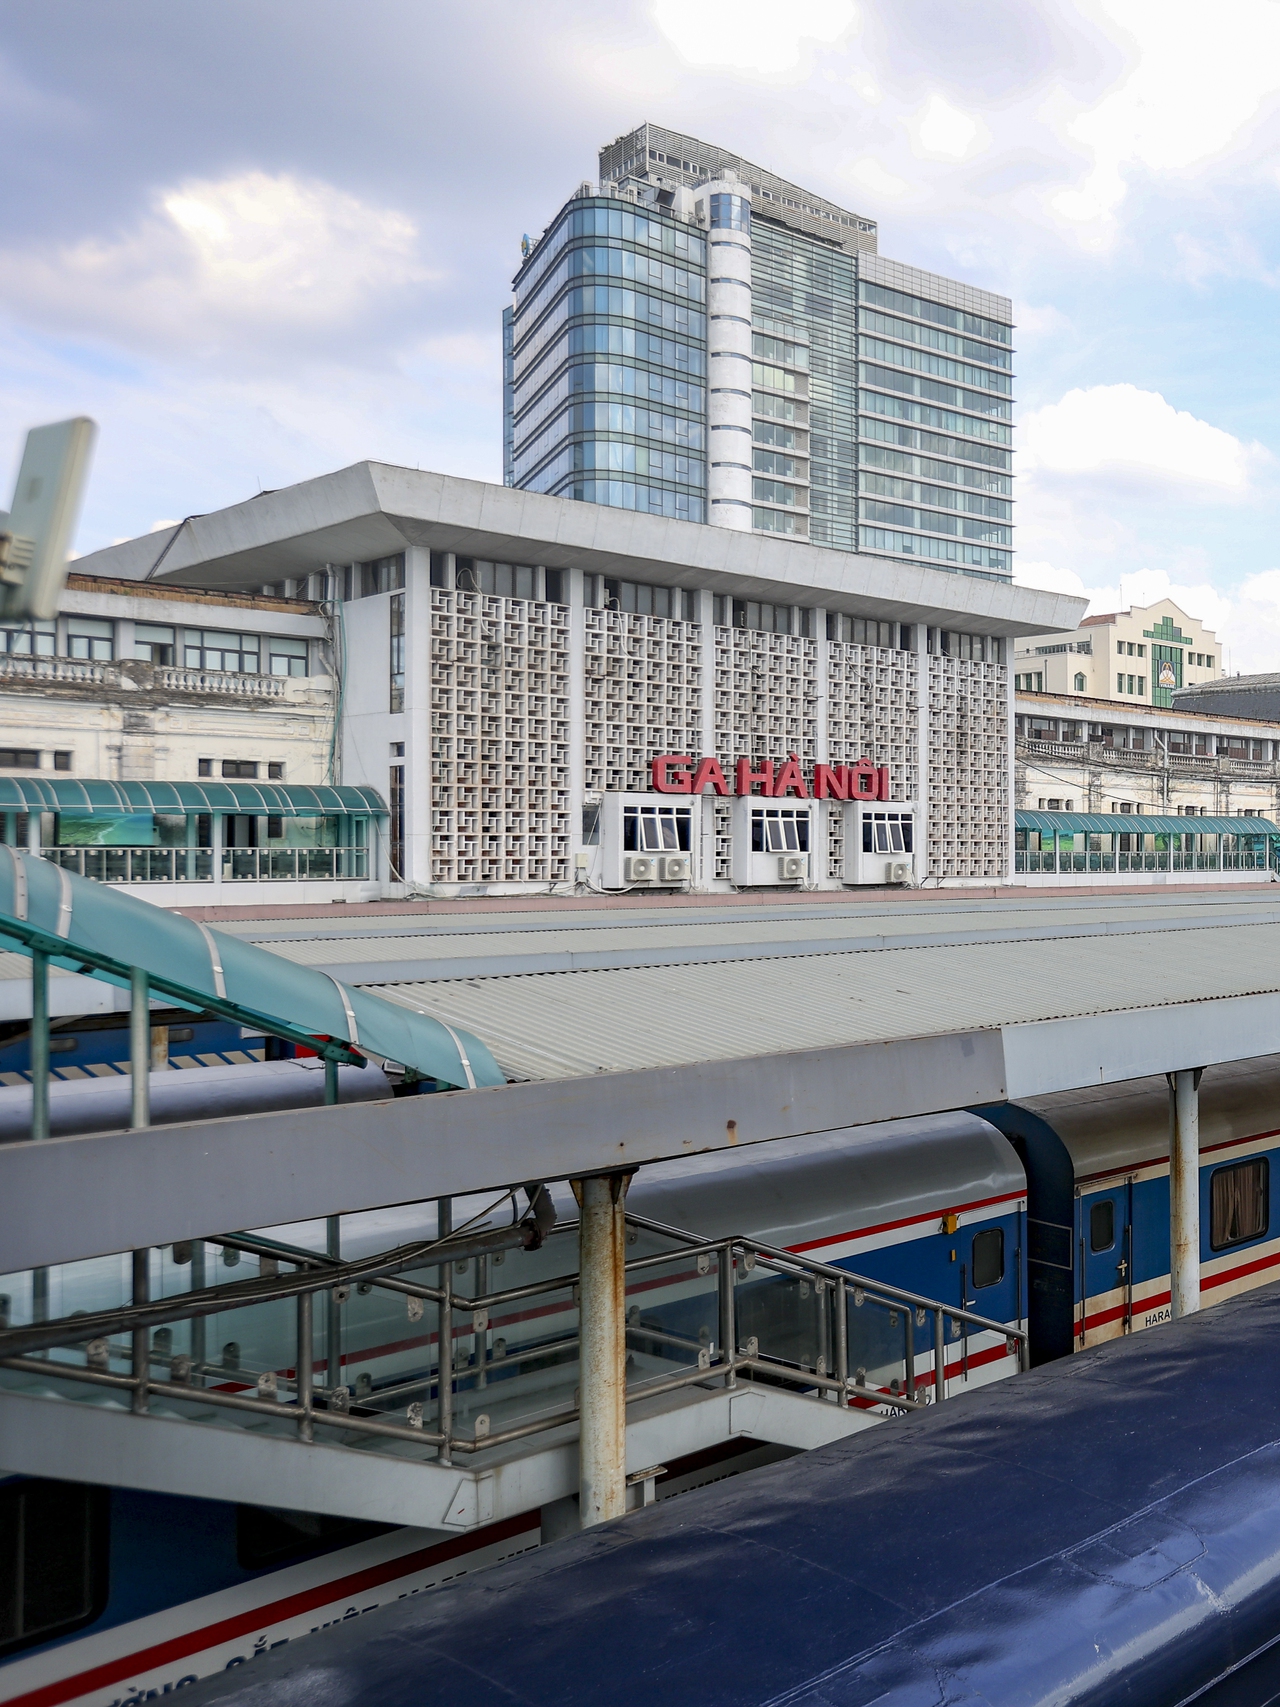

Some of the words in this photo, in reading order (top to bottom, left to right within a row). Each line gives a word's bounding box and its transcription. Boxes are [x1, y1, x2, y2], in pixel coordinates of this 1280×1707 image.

[652, 755, 729, 796] GA
[737, 752, 809, 799] HÀ
[1145, 1309, 1171, 1327] HARA
